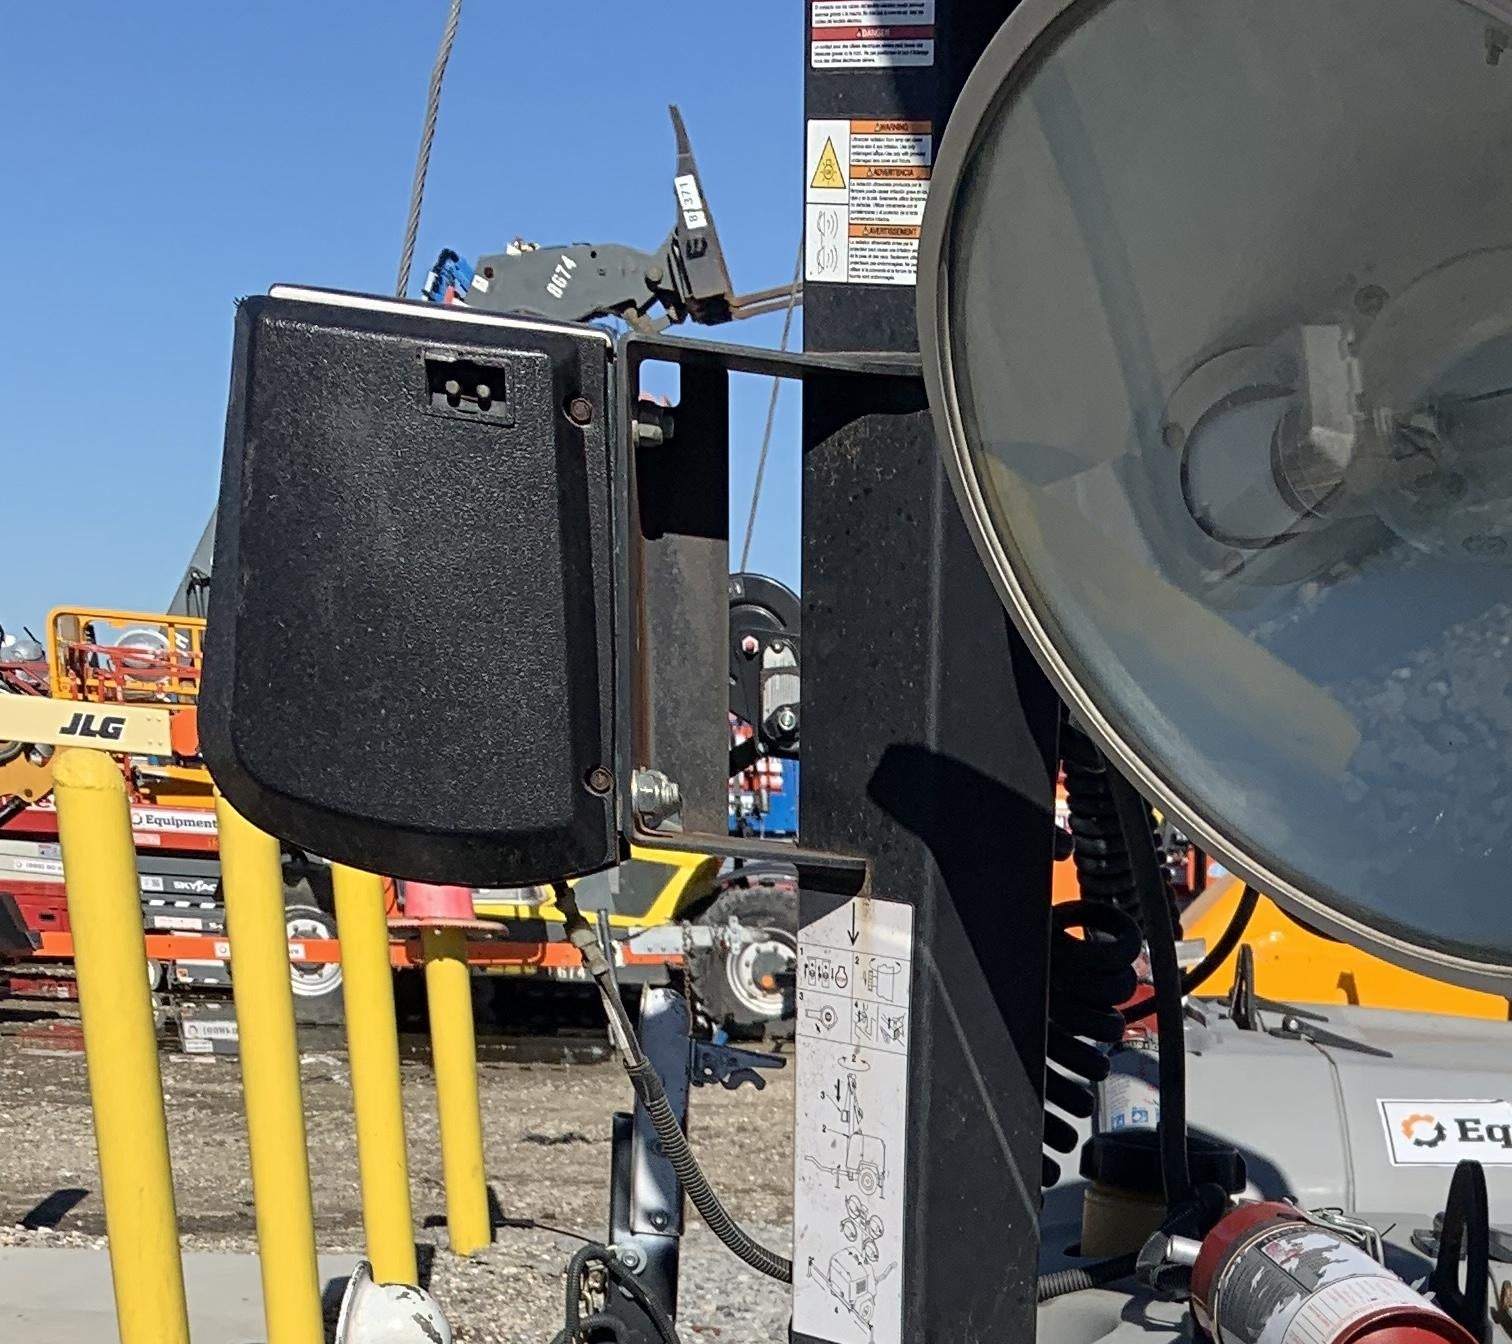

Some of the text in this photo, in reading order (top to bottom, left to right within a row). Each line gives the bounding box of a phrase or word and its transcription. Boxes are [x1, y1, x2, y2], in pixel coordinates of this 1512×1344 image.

[546, 255, 577, 299] 0674
[59, 713, 126, 740] JLG
[173, 879, 218, 892] SKYJAC
